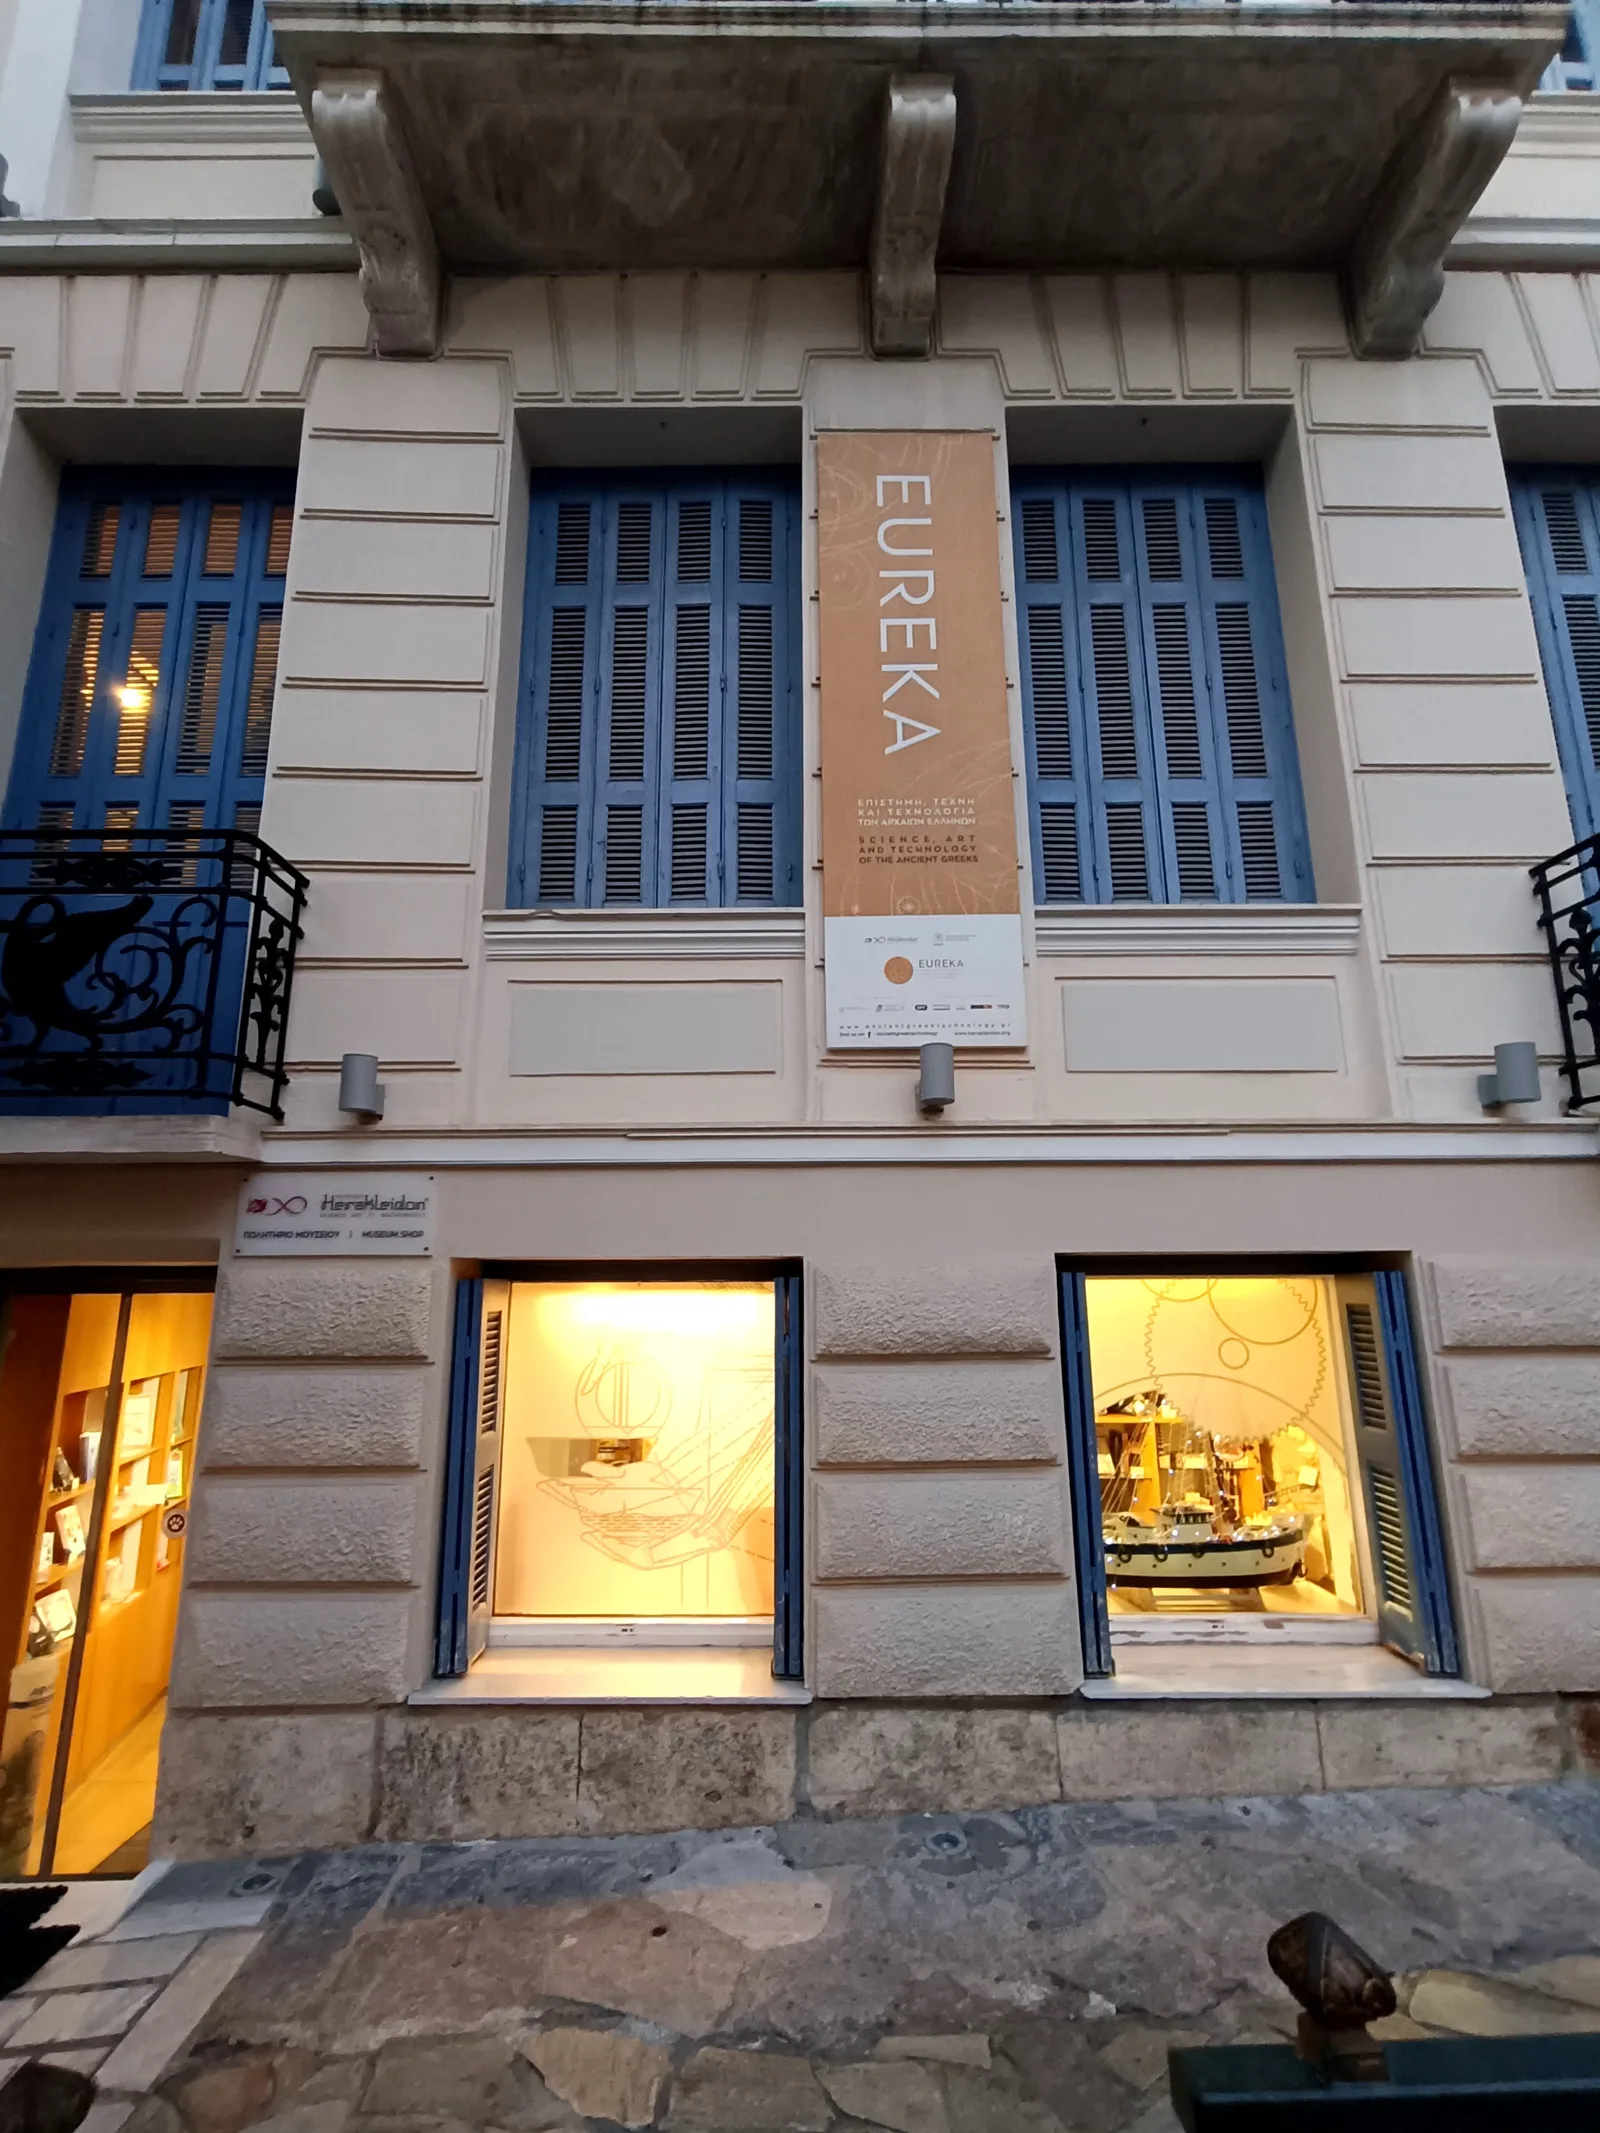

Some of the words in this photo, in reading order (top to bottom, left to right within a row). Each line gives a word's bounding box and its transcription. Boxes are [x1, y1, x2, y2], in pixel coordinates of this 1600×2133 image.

[876, 475, 942, 755] EUREKA
[858, 808, 880, 816] ΚΑΙ
[887, 807, 975, 816] ΤΕΧΝΟΛΟΓΙΑ
[858, 818, 879, 826] ΤΩΝ
[881, 818, 925, 826] ΑΡΧΑΙΩΝ
[927, 817, 976, 825] ΕΛΛΗΝΩΝ
[945, 834, 976, 842] ART
[859, 846, 884, 854] AND
[890, 844, 976, 853] TECHNOLOGY
[859, 856, 872, 864] OF
[875, 856, 894, 864] THE
[896, 856, 938, 864] ANCIENT
[941, 855, 979, 863] GREEKS
[918, 959, 964, 968] EUREKA
[361, 1229, 399, 1239] MUSEUM
[400, 1229, 424, 1239] SHOP
